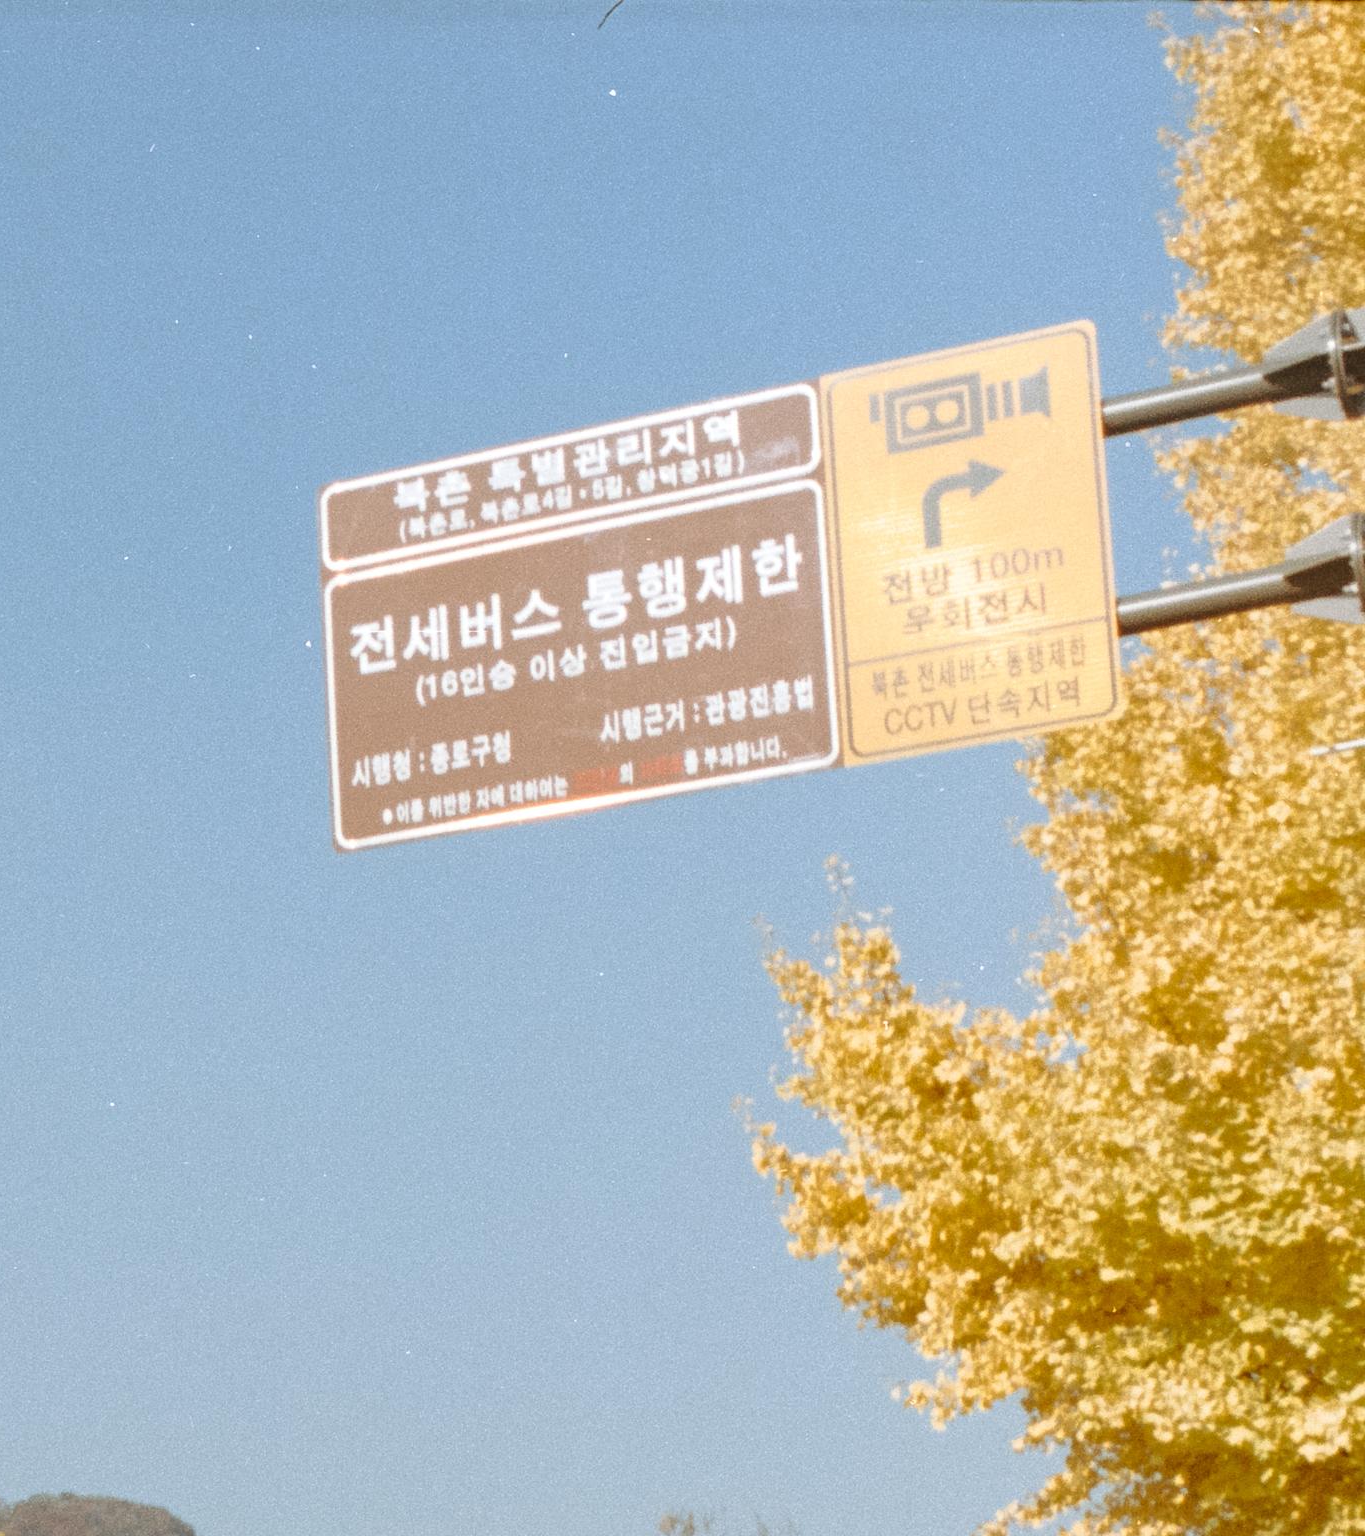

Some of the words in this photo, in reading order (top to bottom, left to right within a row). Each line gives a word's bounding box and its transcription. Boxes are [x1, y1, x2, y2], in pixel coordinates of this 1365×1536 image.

[393, 469, 472, 513] 북촌
[488, 408, 741, 493] 특별관리지역
[350, 587, 563, 675] 전세버스
[582, 532, 803, 630] 통행제한
[883, 562, 952, 606] 전방
[971, 546, 1065, 584] 100m
[416, 658, 517, 707] (16인승
[529, 643, 587, 682] 이상
[599, 614, 737, 672] 진입금지)
[872, 665, 911, 700] 북촌
[918, 652, 998, 693] 전세버스
[1006, 634, 1087, 679] 통행제한
[600, 697, 686, 744] 시행근거
[705, 674, 815, 727] 관광진흥법
[884, 699, 958, 736] CCTV
[968, 675, 1081, 727] 단속지역
[351, 746, 412, 788] 시행청
[430, 729, 512, 775] 종로구청
